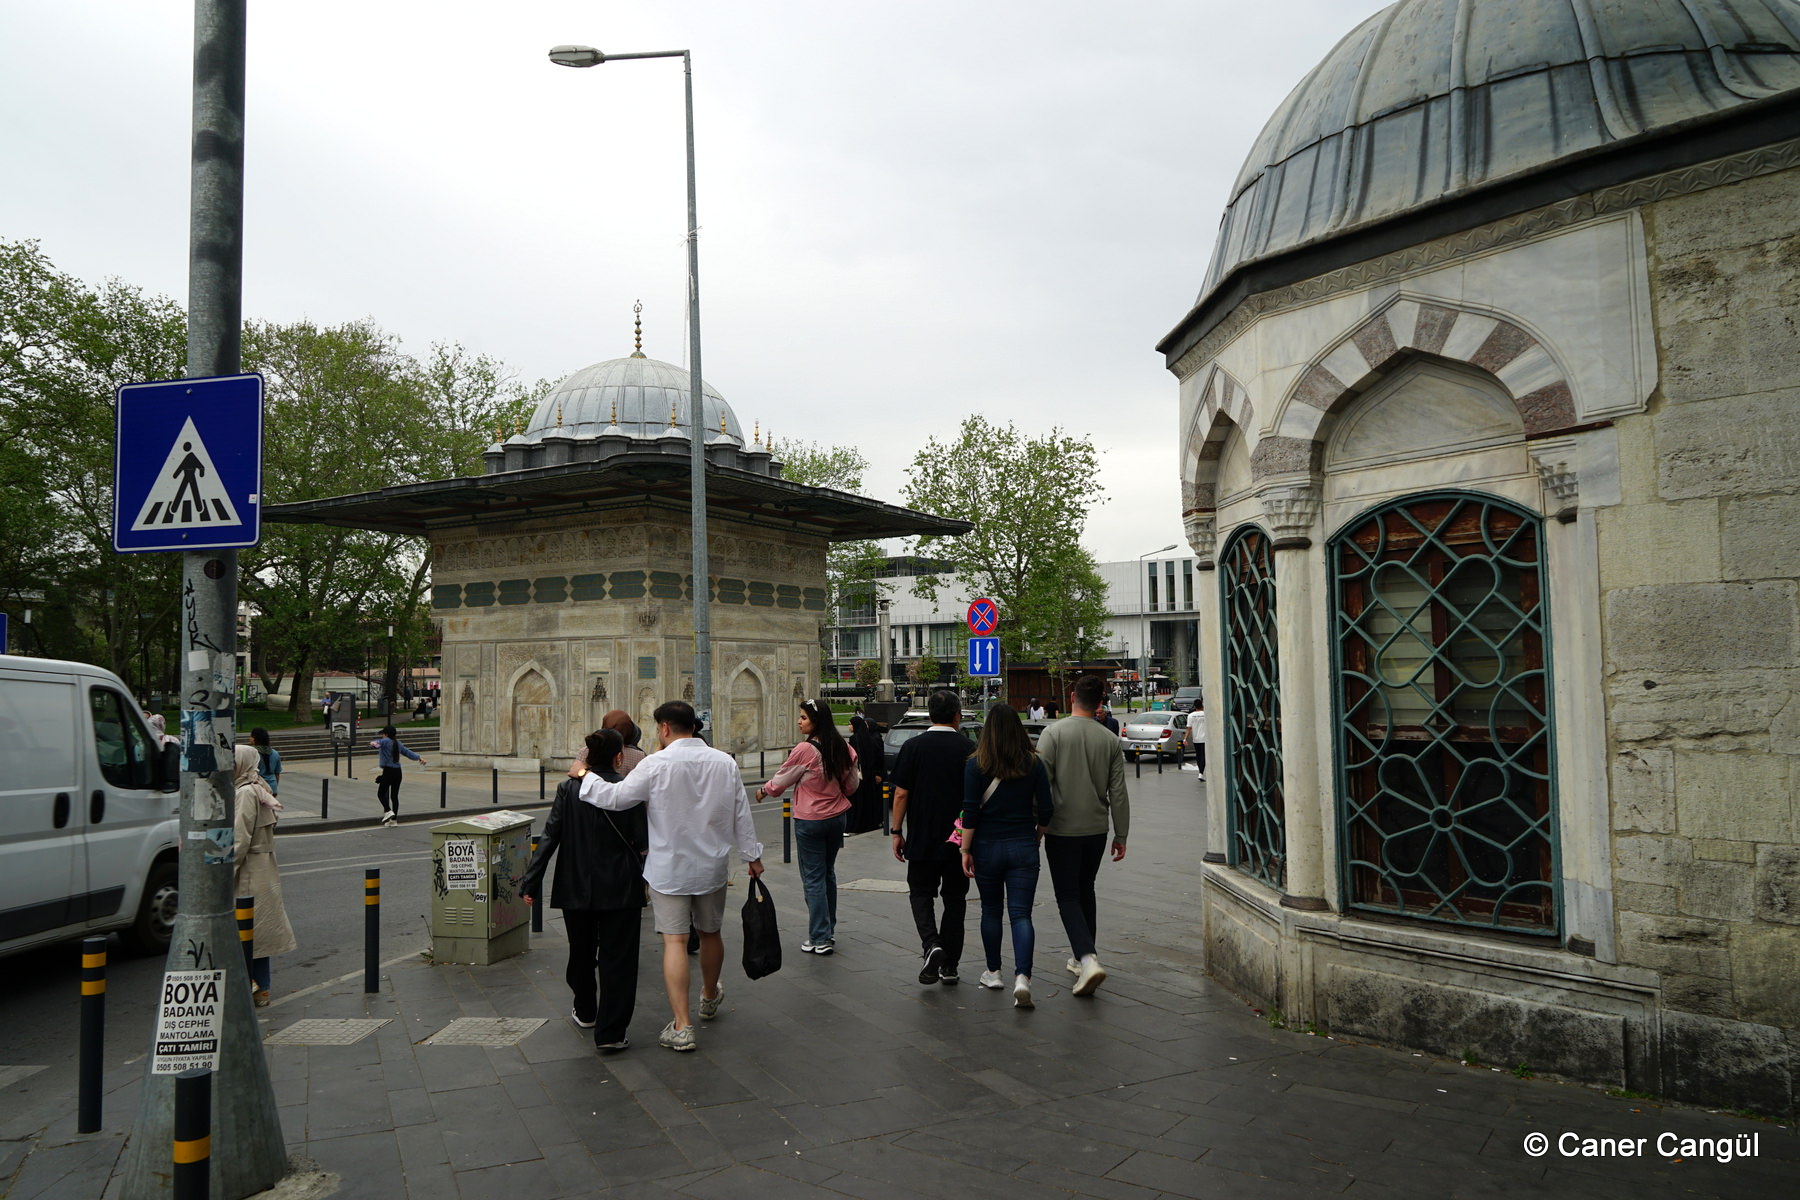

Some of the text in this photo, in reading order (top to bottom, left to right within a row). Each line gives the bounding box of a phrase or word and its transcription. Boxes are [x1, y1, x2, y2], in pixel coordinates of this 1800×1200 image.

[448, 845, 474, 856] BOYA
[164, 982, 219, 1004] BOYA
[163, 1005, 215, 1018] BADANA
[164, 1019, 210, 1031] DIŞ CEPHE
[160, 1031, 215, 1040] MANTOLAMA
[159, 1042, 213, 1055] ÇATI TAMİRİ
[173, 1063, 187, 1071] 508
